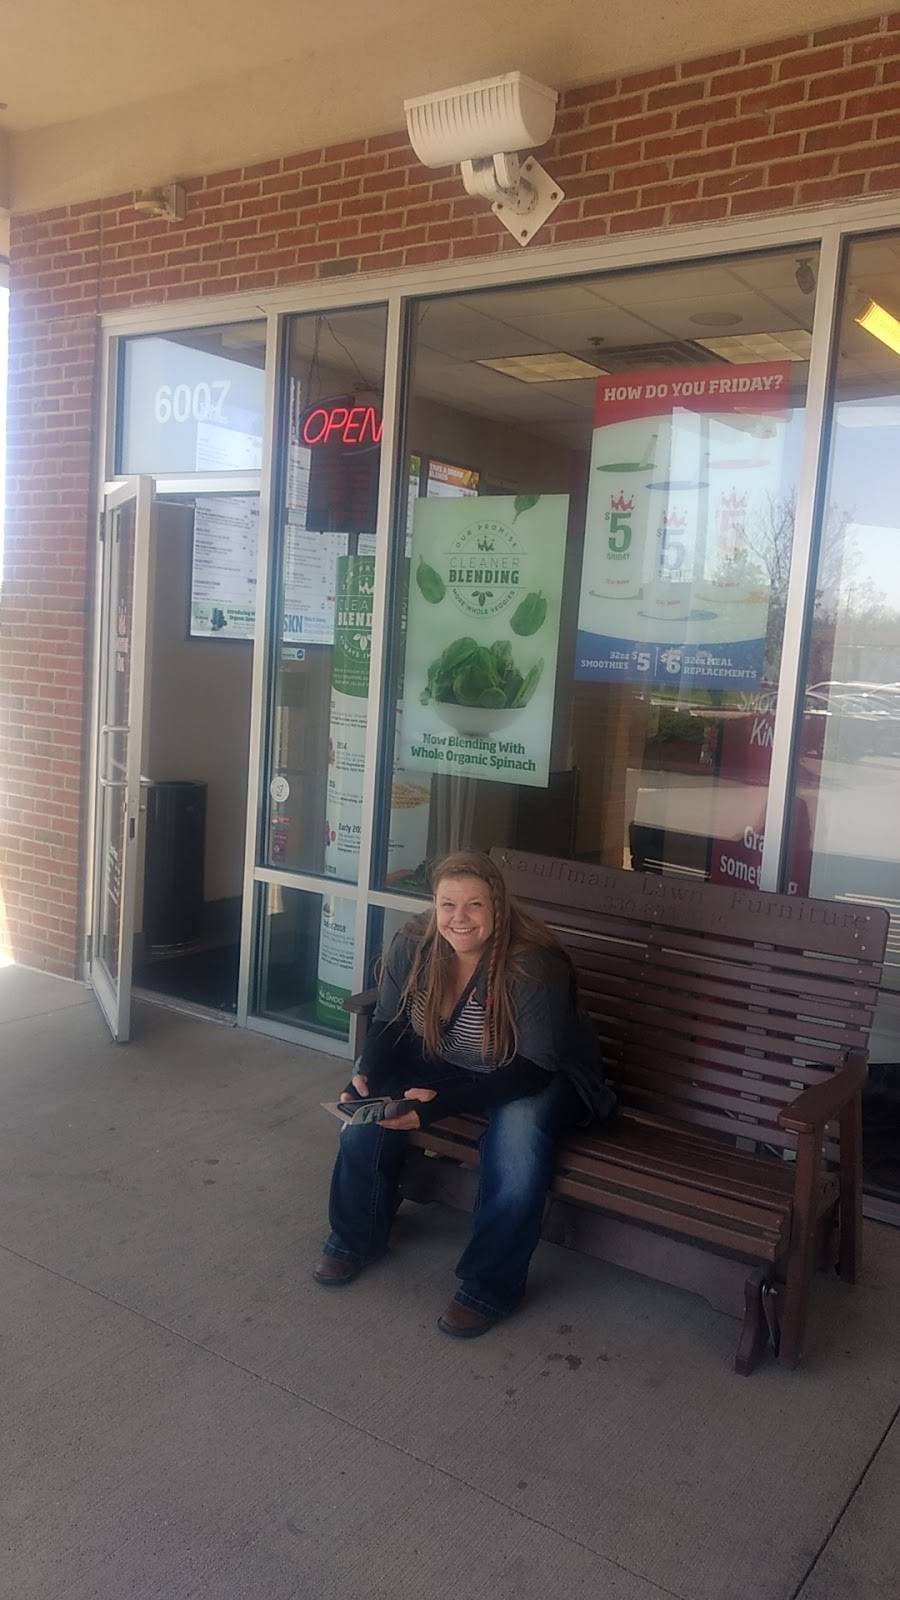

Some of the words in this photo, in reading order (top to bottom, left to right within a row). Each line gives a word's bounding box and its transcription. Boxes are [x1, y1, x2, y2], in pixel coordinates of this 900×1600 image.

[604, 385, 643, 401] HOW
[645, 384, 668, 399] DO
[672, 380, 707, 397] YOU
[709, 373, 784, 394] FRIDAY?
[154, 379, 233, 424] 6007
[303, 407, 385, 443] OPEN
[478, 523, 518, 548] PROMISE
[604, 511, 632, 553] $5
[449, 556, 520, 569] CLEANER
[448, 569, 520, 585] BLENDING
[580, 659, 630, 670] SMOOTHIES
[631, 651, 650, 671] $5
[683, 665, 757, 679] REPLACEMENTS
[423, 733, 447, 746] Now
[448, 736, 497, 754] Blending
[498, 741, 526, 755] With
[410, 745, 445, 760] Whole
[446, 750, 489, 766] Organic
[489, 755, 537, 772] Spinach
[744, 825, 765, 851] Gra
[502, 852, 617, 889] Kauffman
[730, 891, 868, 931] Furniture
